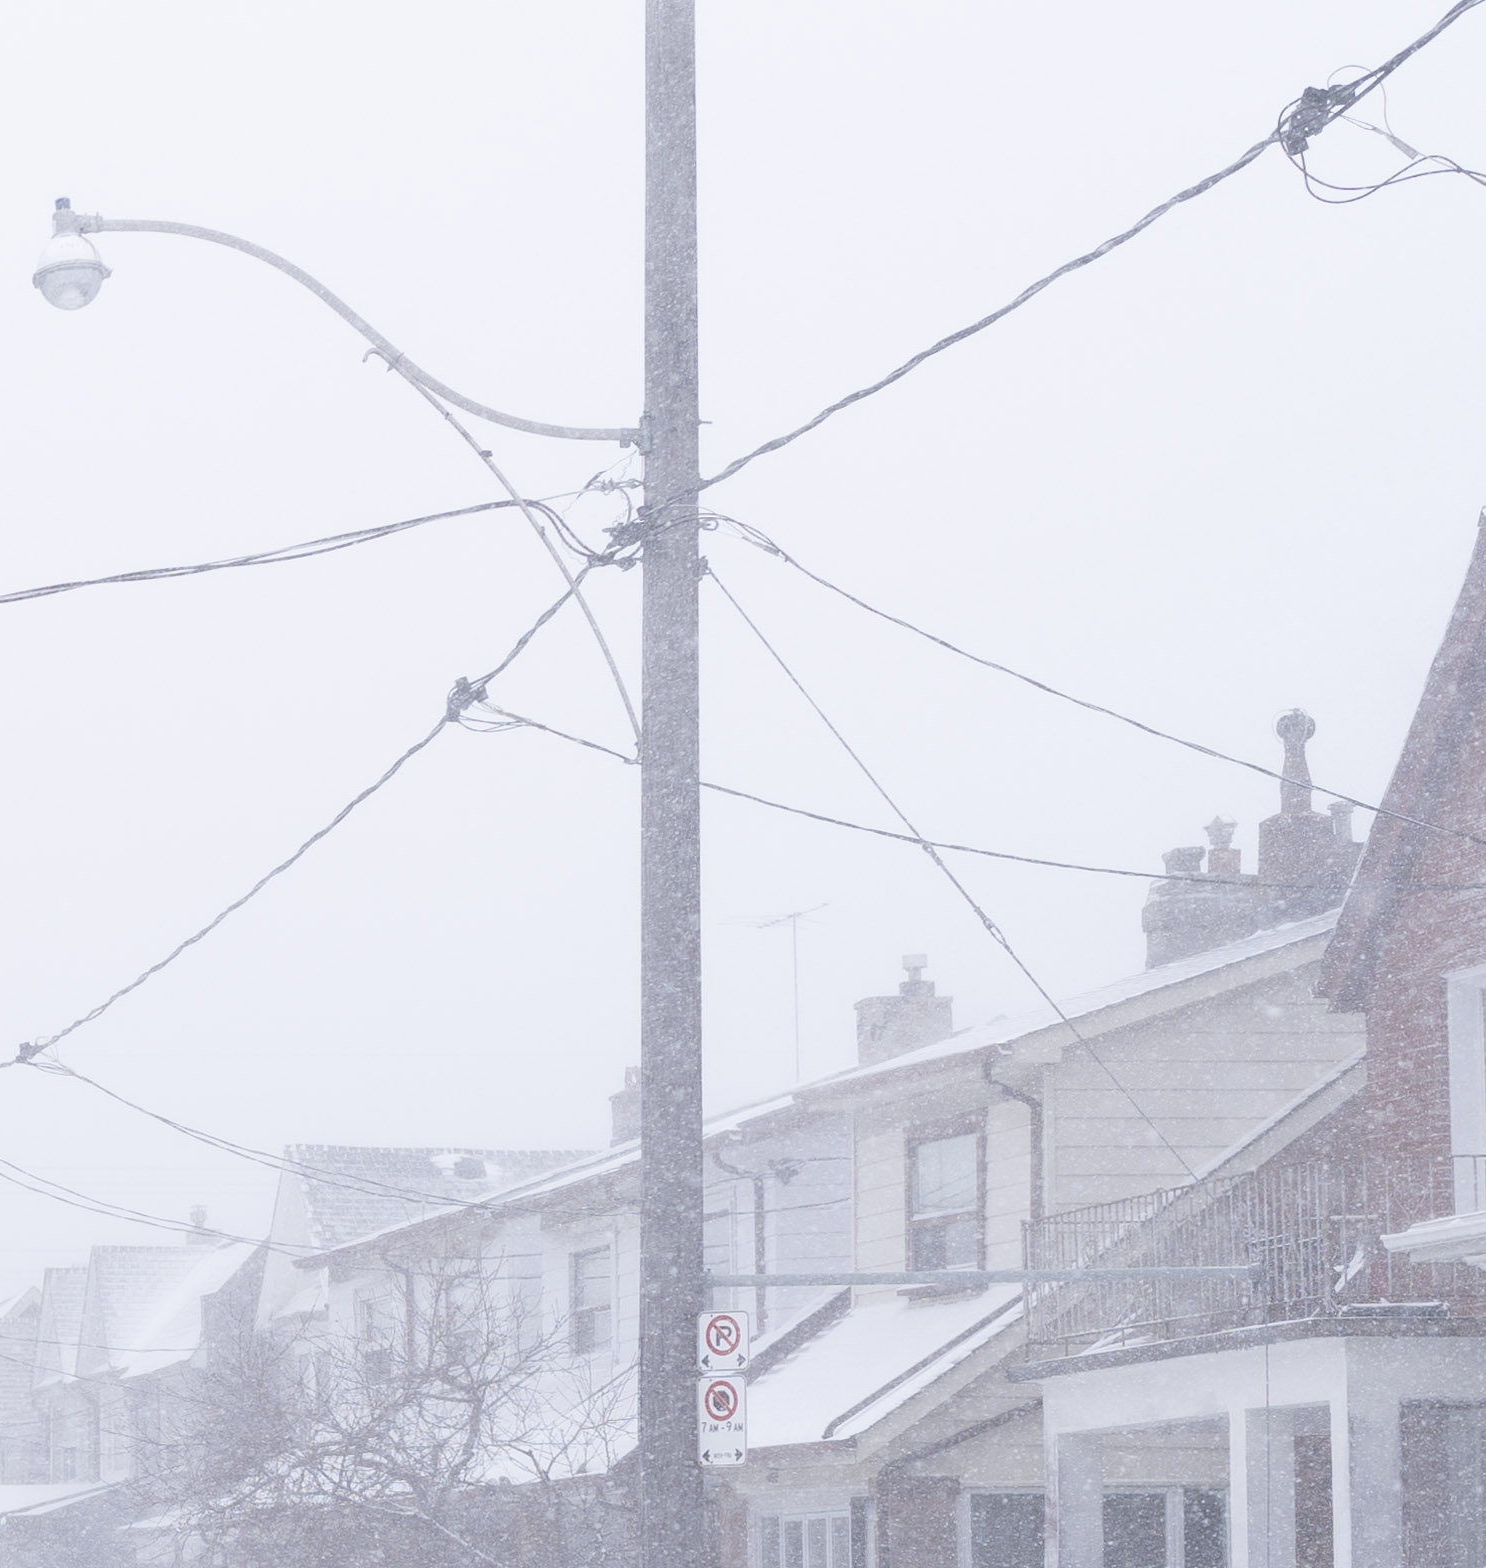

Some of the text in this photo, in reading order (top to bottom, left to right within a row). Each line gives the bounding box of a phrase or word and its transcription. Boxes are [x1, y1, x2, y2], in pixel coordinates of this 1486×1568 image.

[715, 1325, 732, 1347] P
[701, 1421, 708, 1433] 7
[709, 1423, 720, 1433] AM
[726, 1421, 732, 1433] 9
[733, 1423, 744, 1433] AM
